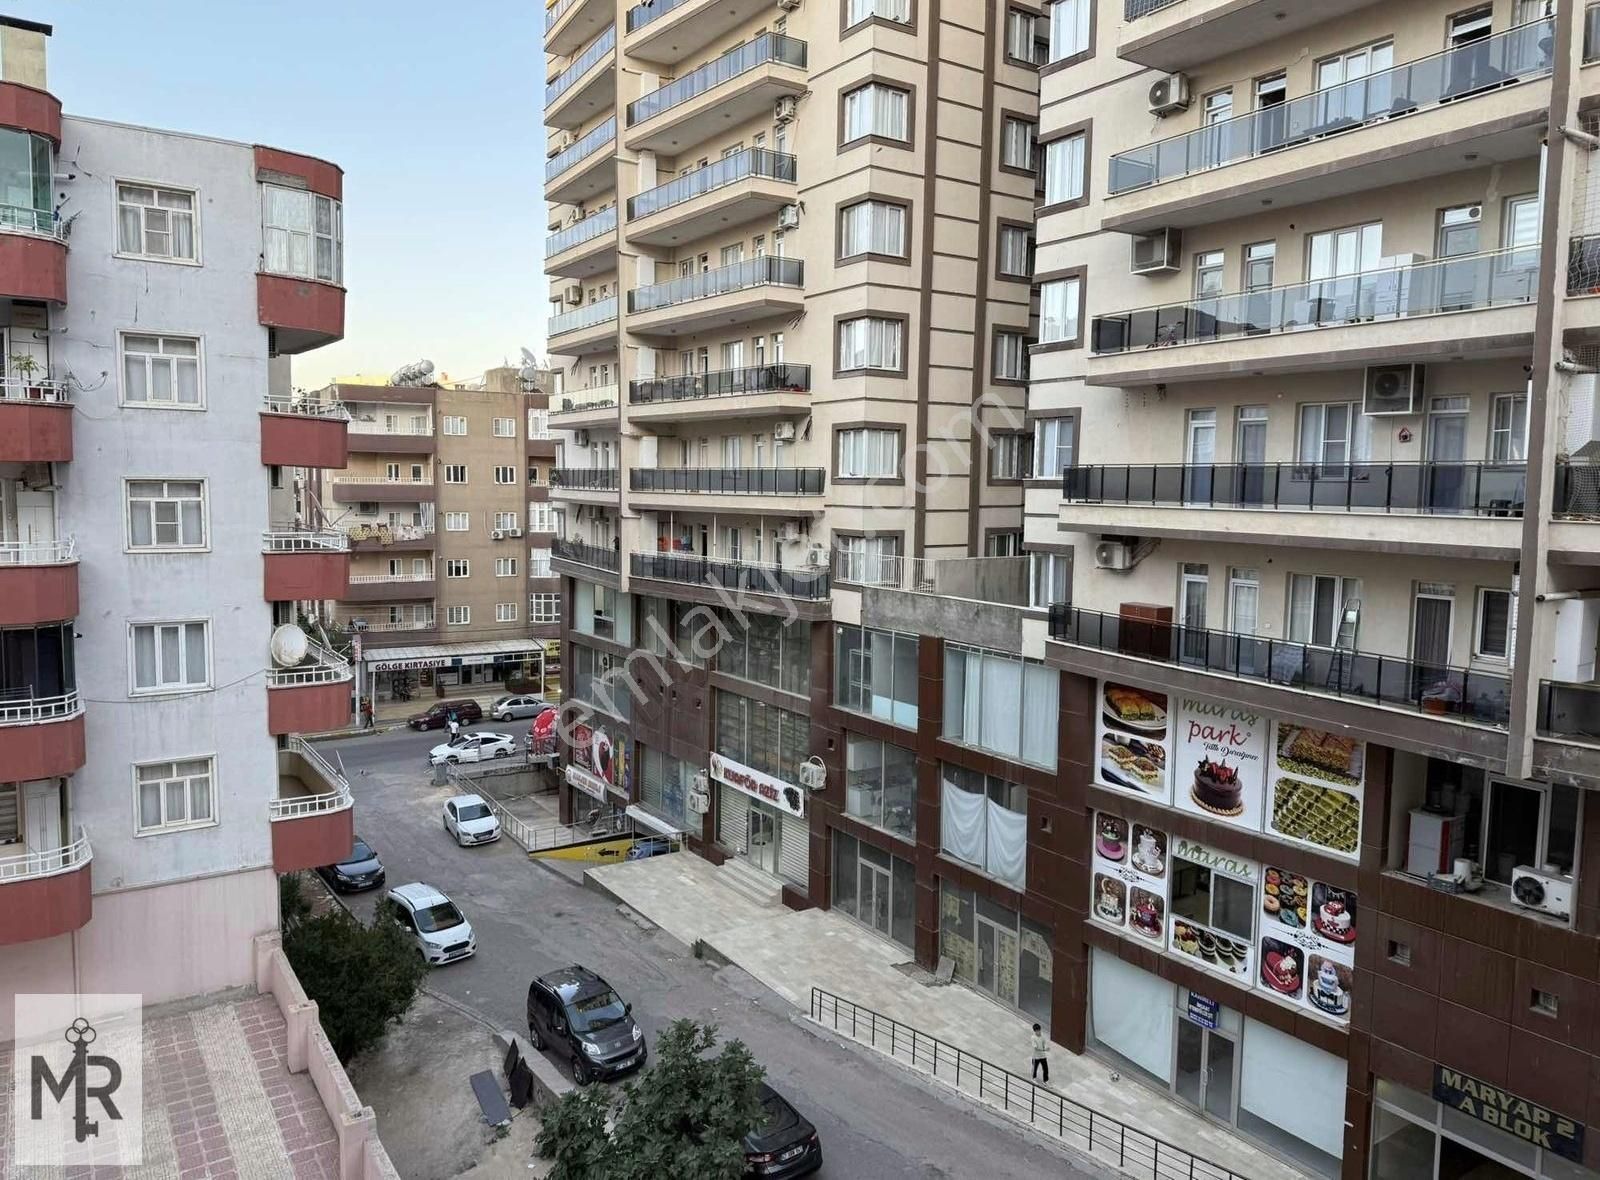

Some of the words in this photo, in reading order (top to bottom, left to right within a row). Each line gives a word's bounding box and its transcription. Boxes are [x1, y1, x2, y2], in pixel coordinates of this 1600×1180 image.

[375, 662, 403, 671] GÖLGE
[1187, 719, 1248, 746] park
[1442, 1068, 1551, 1125] MARYAP
[1556, 1117, 1576, 1140] 2
[1458, 1096, 1478, 1117] A
[1482, 1104, 1552, 1149] BLOK
